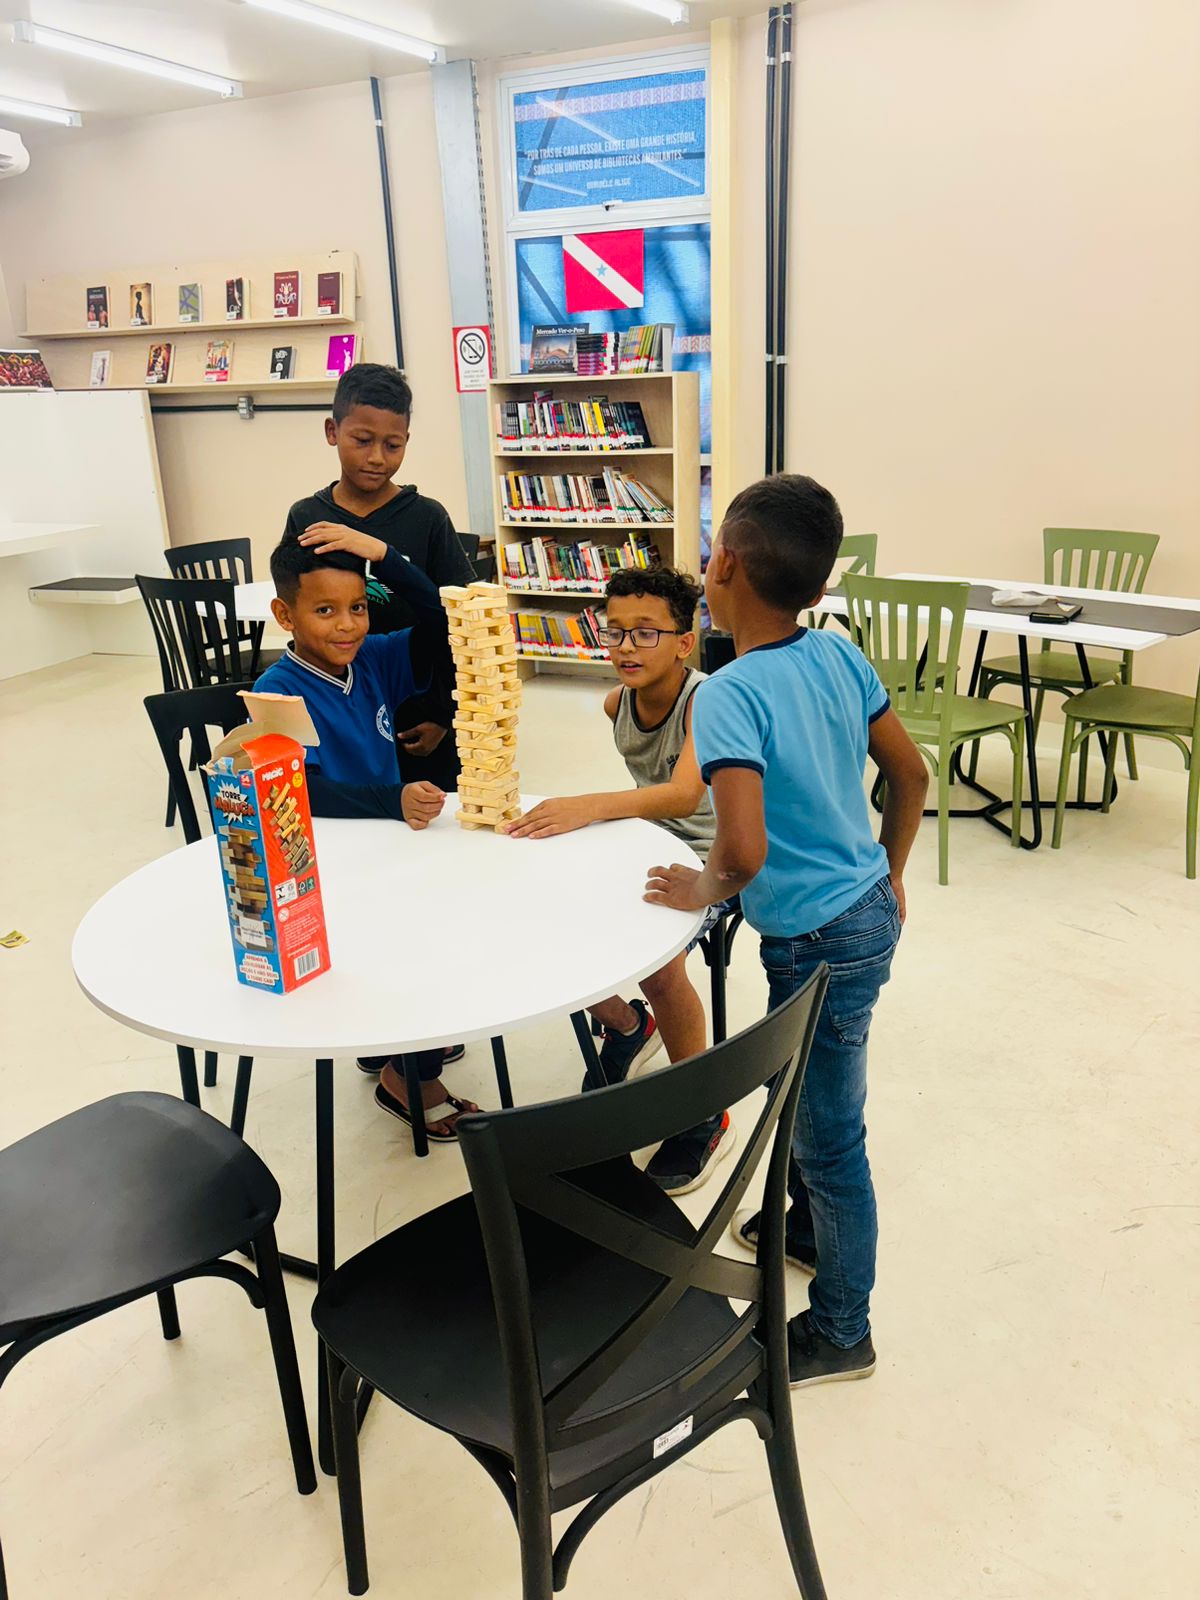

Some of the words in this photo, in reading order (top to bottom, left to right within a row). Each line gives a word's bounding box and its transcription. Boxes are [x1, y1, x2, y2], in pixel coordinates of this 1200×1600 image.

[563, 144, 579, 157] CADA
[626, 138, 640, 150] UMA
[640, 134, 665, 148] GRANDE
[533, 162, 554, 176] SOMOS
[554, 162, 564, 174] UM
[564, 158, 594, 173] UNIVERSO
[594, 158, 602, 170] DE
[602, 152, 641, 168] BIBLIOTECAS
[214, 796, 256, 817] MALUCA
[221, 790, 242, 802] TORRE
